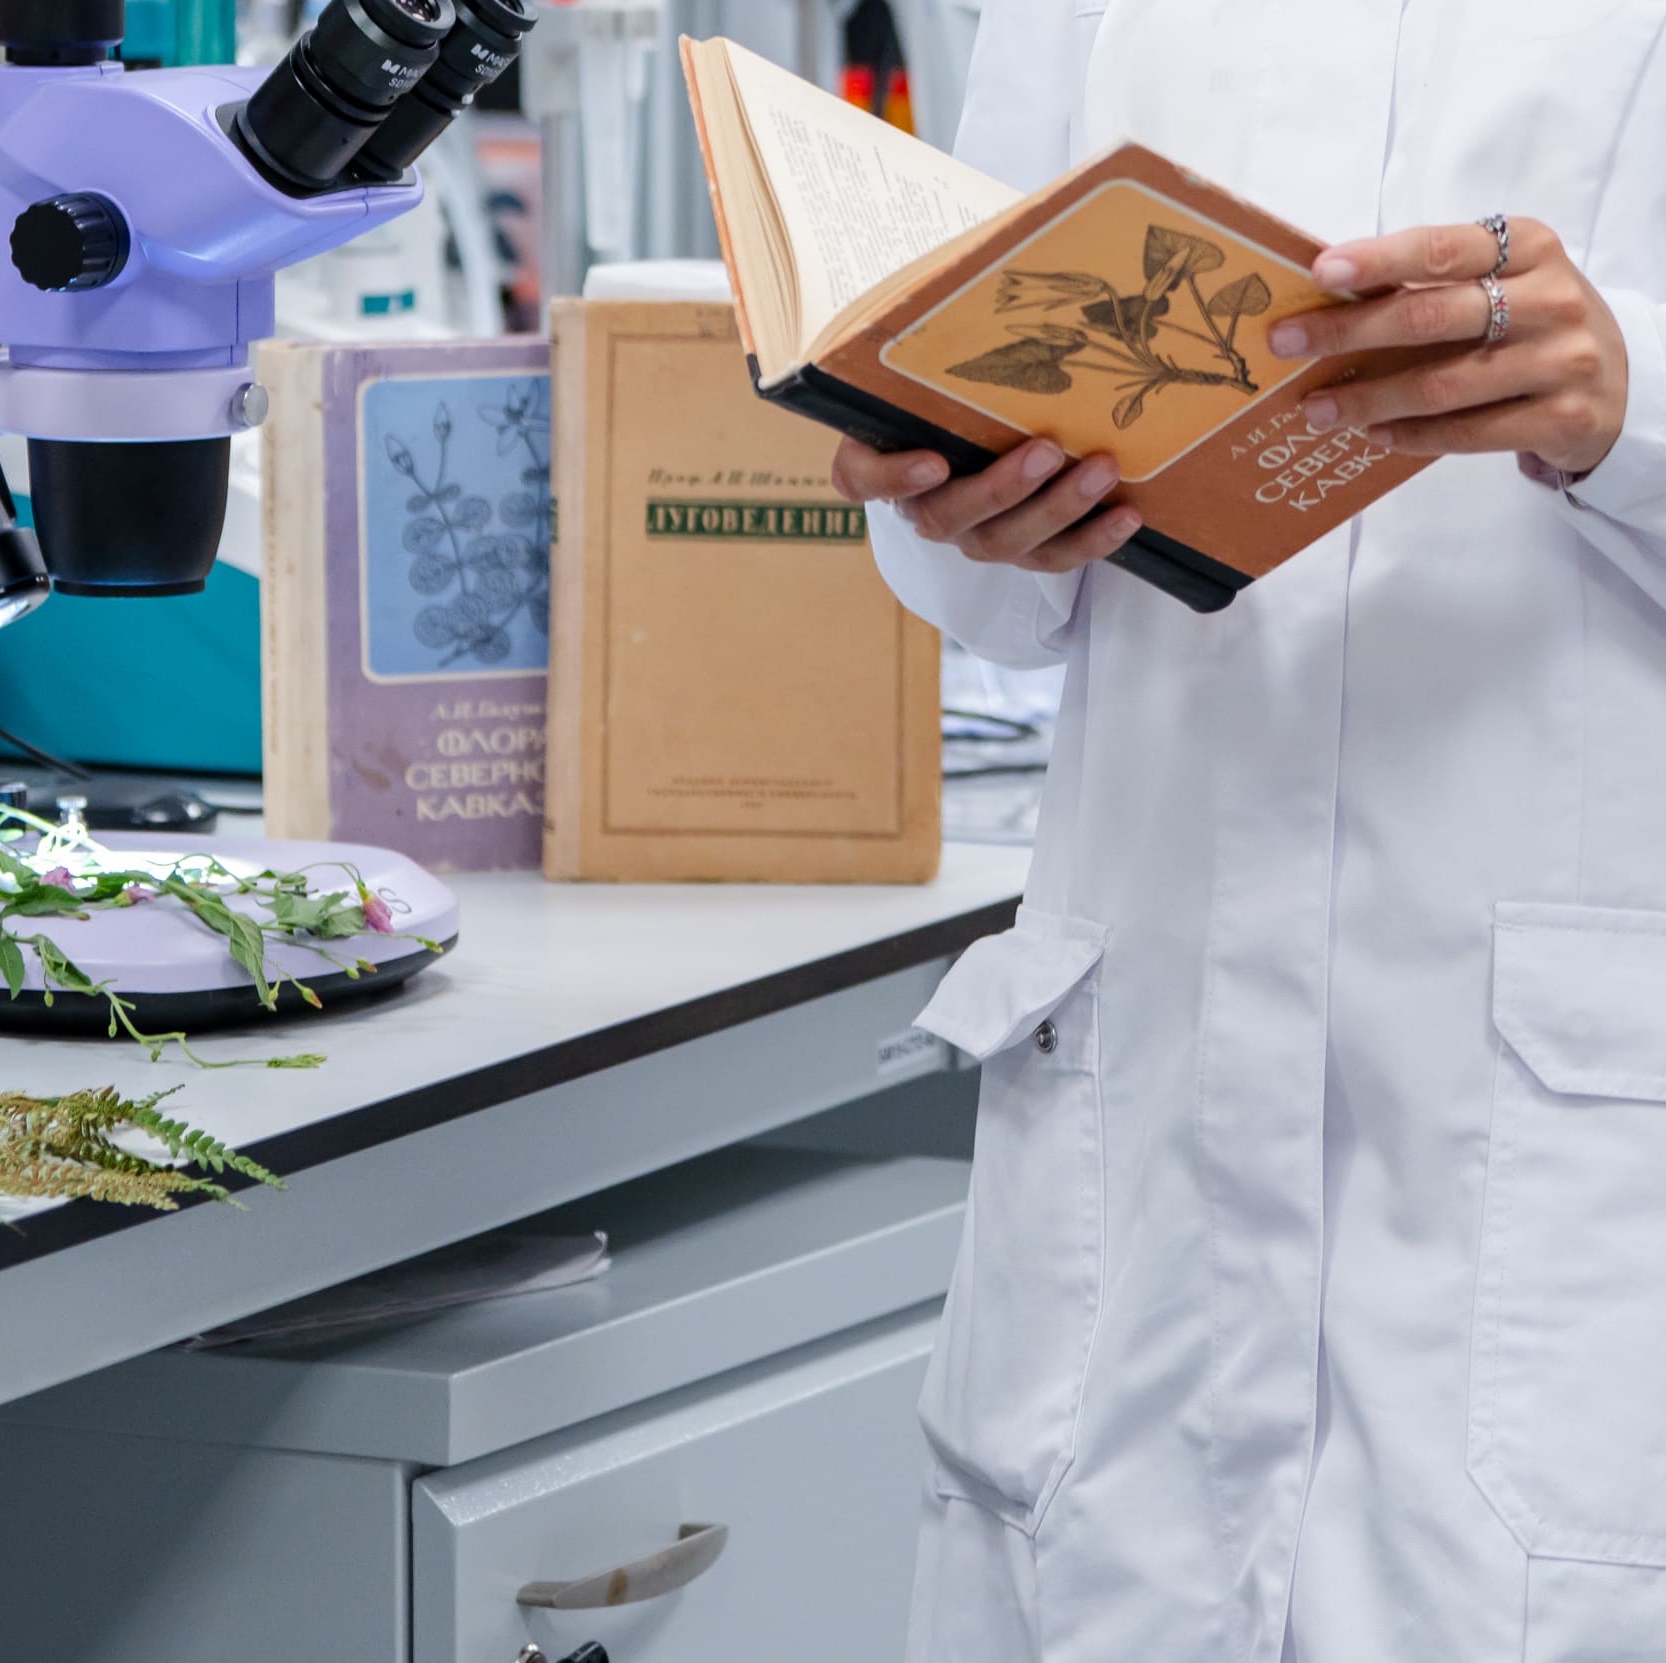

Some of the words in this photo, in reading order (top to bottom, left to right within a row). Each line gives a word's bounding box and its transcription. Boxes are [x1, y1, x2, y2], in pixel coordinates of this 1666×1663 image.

[1288, 446, 1391, 512] КАВК
[647, 504, 864, 534] ЛУГОВЕДЕНИЕ
[417, 791, 544, 822] КАВКА
